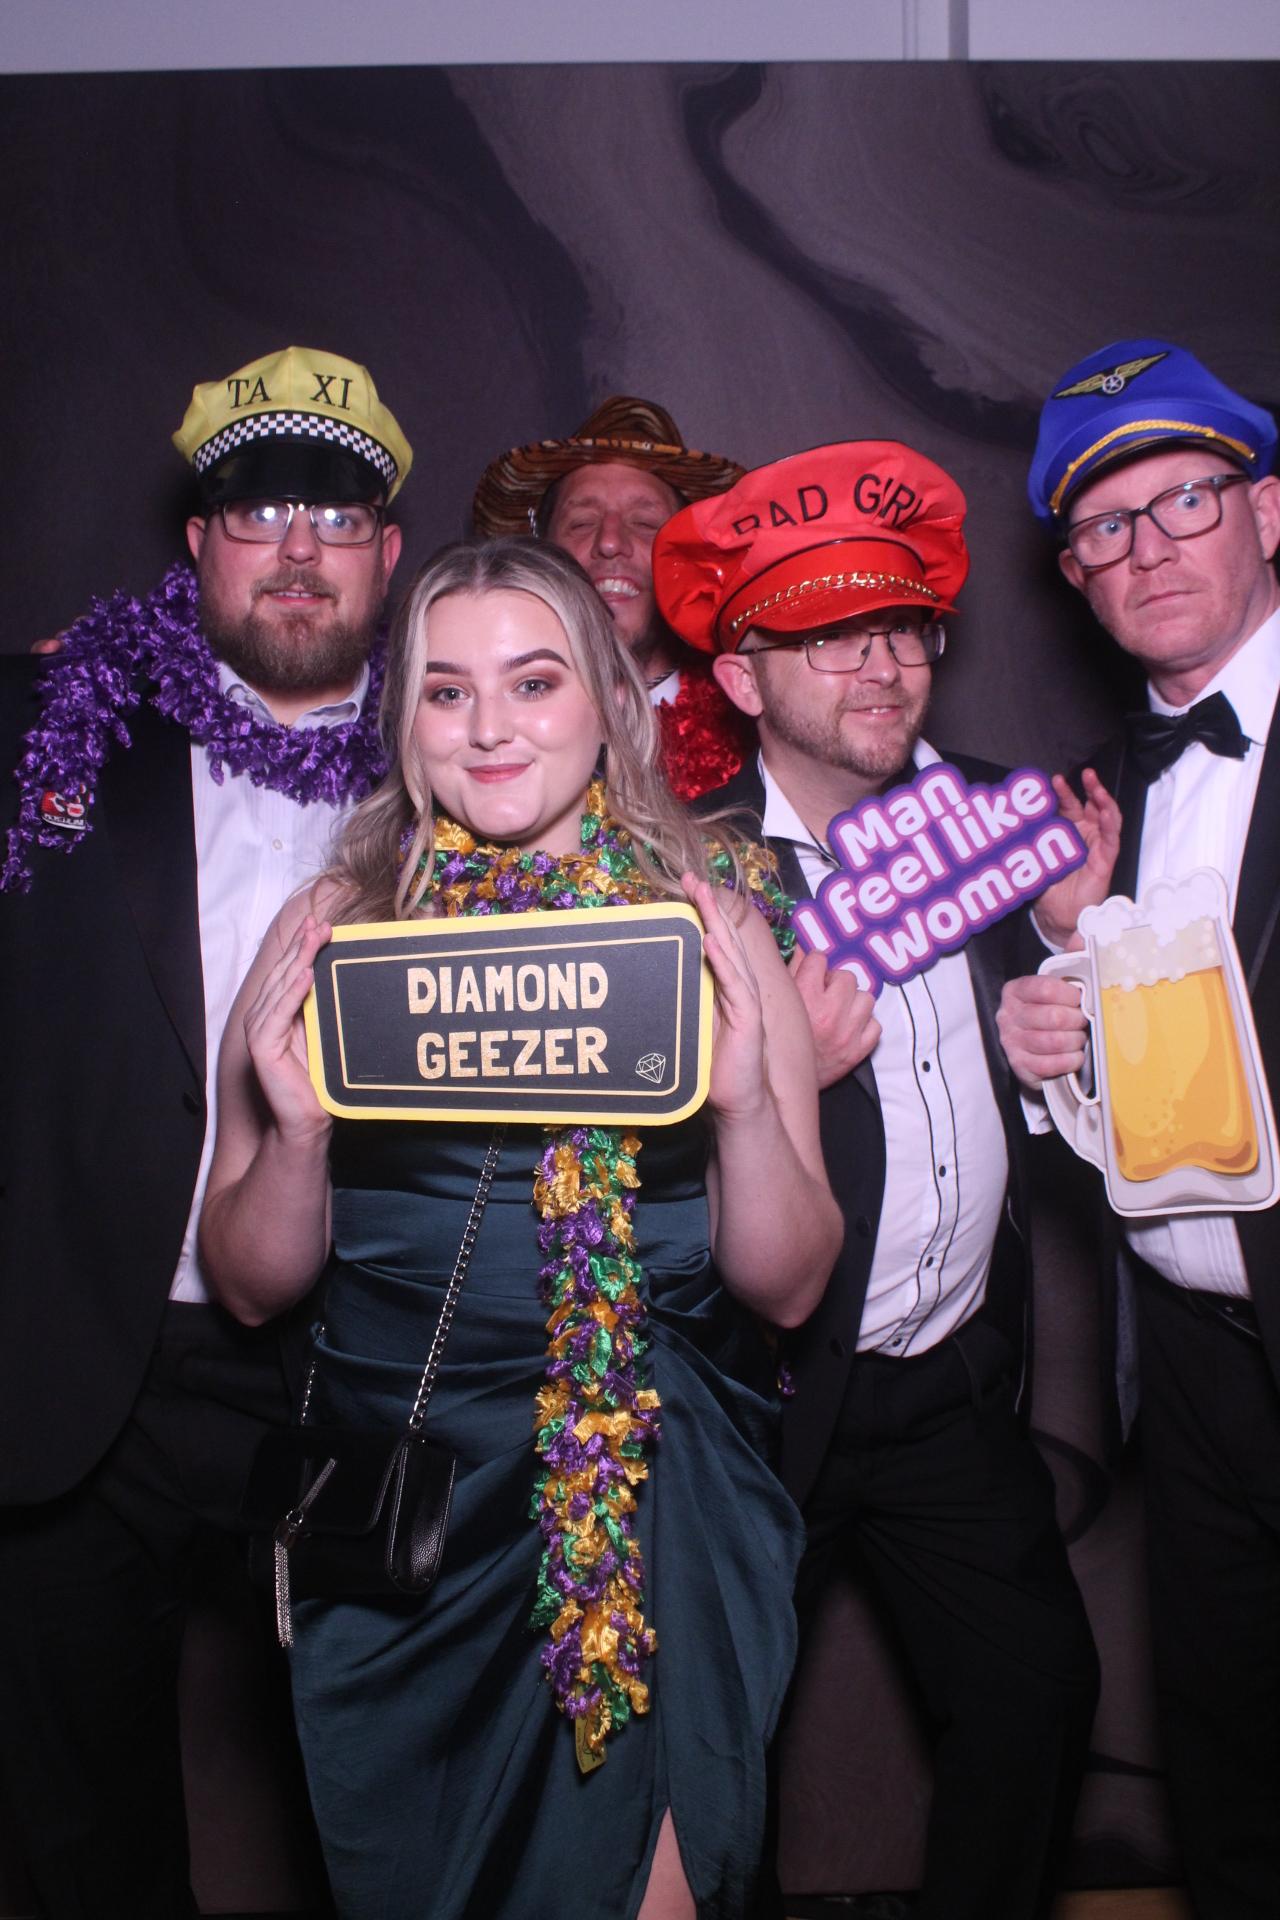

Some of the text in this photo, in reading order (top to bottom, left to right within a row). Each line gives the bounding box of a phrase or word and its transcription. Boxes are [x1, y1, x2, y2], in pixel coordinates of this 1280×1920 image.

[798, 777, 1048, 951] I feel like
[838, 773, 962, 868] Man
[868, 827, 1078, 972] woman
[406, 962, 609, 1014] DIAMOND
[416, 1026, 609, 1080] GEEZER
